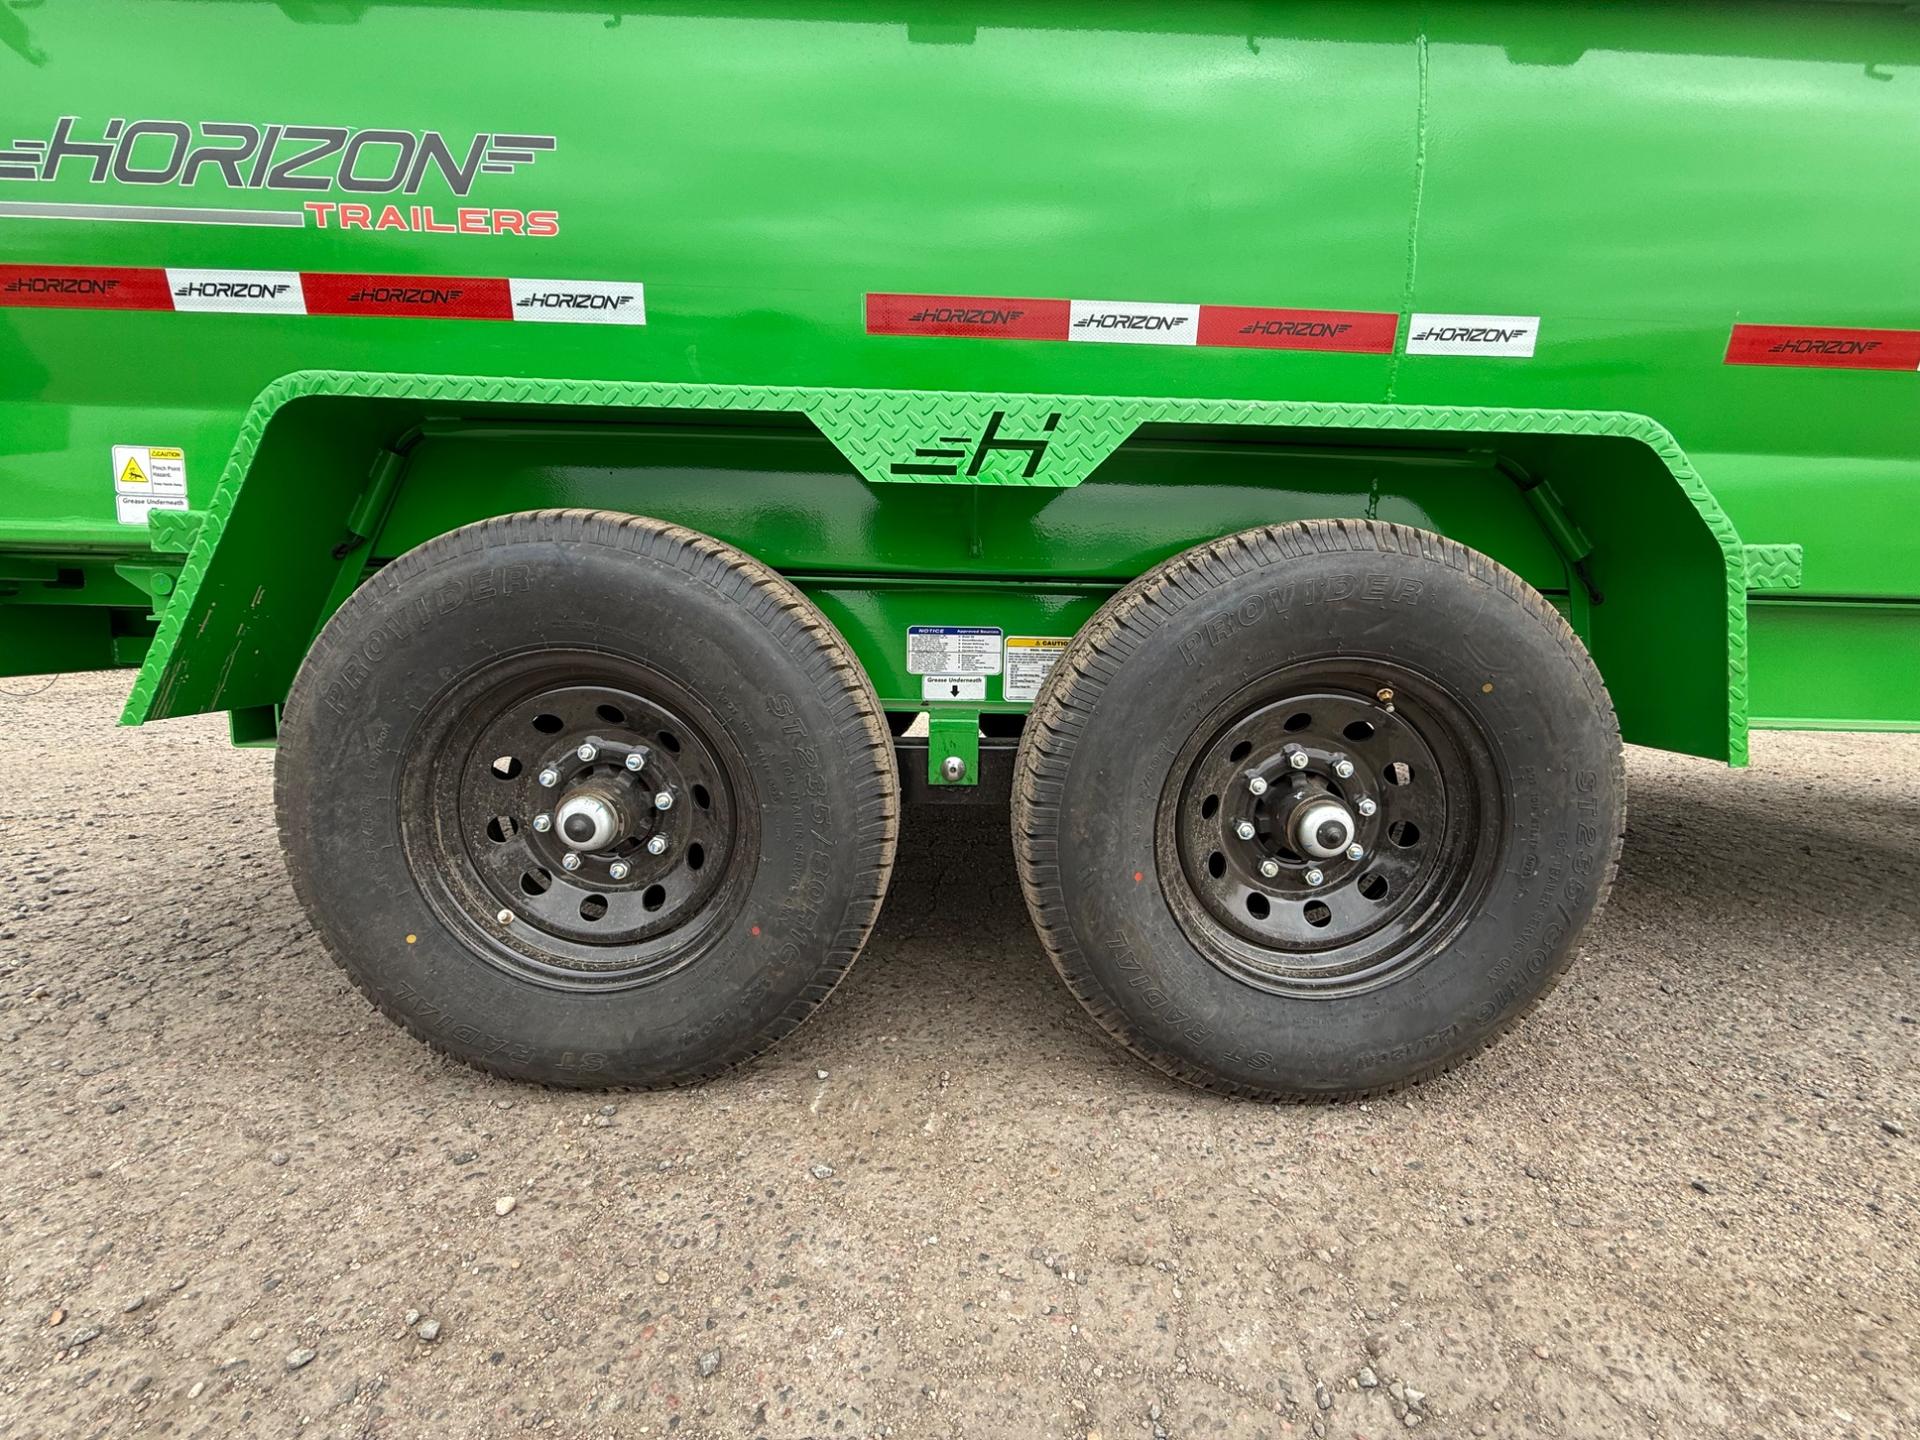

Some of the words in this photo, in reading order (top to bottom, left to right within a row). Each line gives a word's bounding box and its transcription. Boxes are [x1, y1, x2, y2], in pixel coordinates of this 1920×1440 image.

[41, 116, 490, 196] HORIZON
[304, 202, 559, 237] TRAILERS
[18, 277, 107, 294] HORIZON
[190, 282, 276, 299] HORIZON
[358, 287, 450, 304] HORIZON
[528, 292, 620, 310] HORIZON
[923, 307, 1013, 326] HORIZON
[1086, 314, 1175, 332] HORIZON
[1252, 319, 1340, 338] HORIZON
[1423, 325, 1513, 345] HORIZON
[1781, 340, 1870, 355] HORIZON
[146, 498, 185, 506] Underneath
[1177, 573, 1425, 665] PROVIDER
[324, 565, 530, 716] PROVIDER
[1105, 928, 1215, 1046] RADIAL
